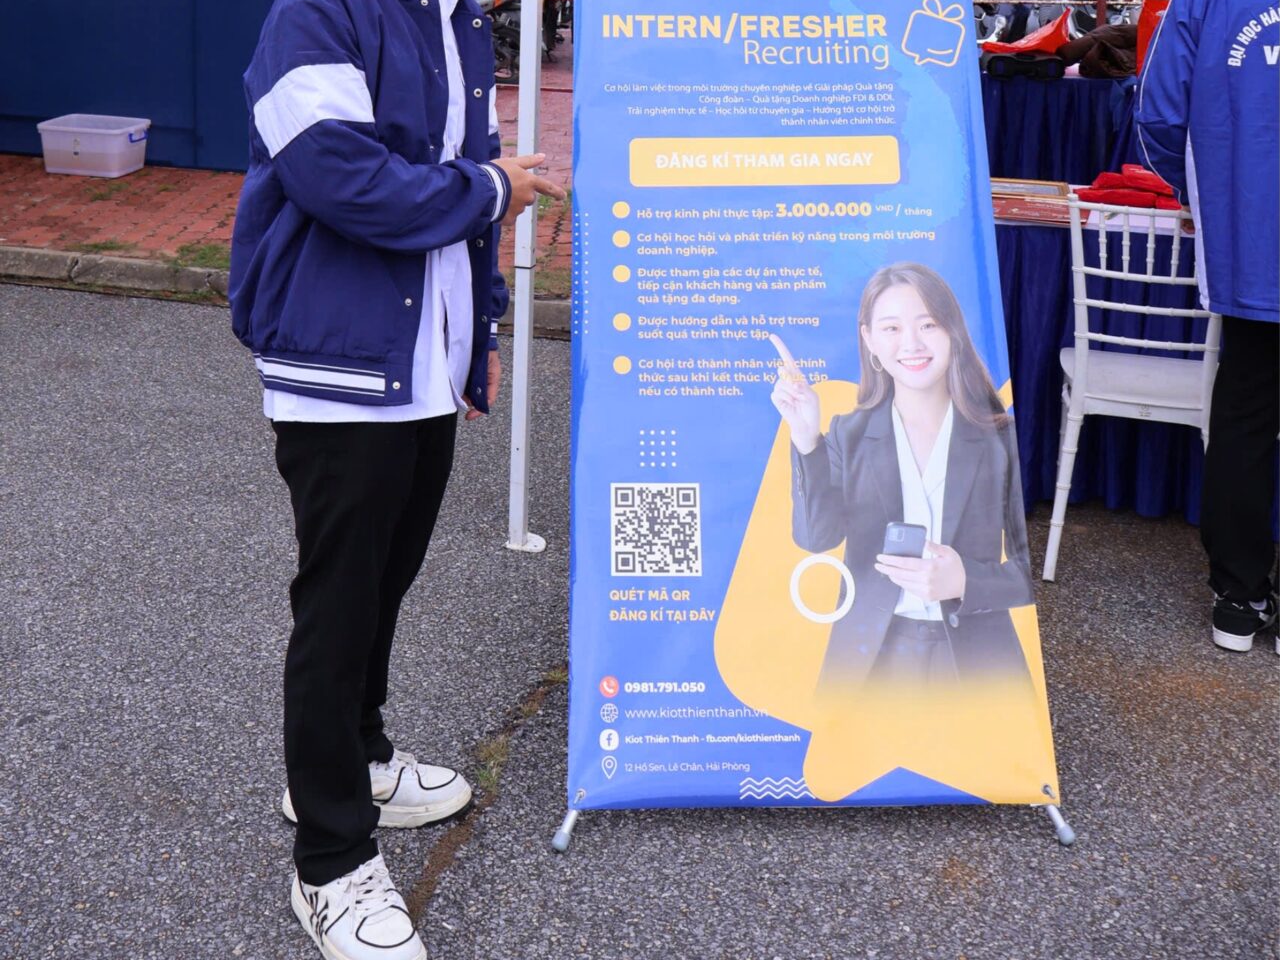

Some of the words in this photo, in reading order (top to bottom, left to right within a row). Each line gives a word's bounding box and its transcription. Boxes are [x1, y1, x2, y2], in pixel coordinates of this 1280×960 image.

[602, 13, 887, 44] INTERN/FRESHER
[1236, 19, 1262, 46] HỌC
[743, 40, 890, 70] Recruiting
[1227, 44, 1246, 67] ĐẠI
[655, 151, 708, 169] ĐĂNG
[734, 153, 785, 168] THAM
[789, 152, 820, 168] GIA
[825, 152, 874, 168] NGAY
[655, 209, 672, 221] trợ
[674, 208, 700, 218] kinh
[702, 208, 721, 220] phí
[723, 209, 749, 219] thực
[775, 202, 872, 218] 3.000.000
[904, 207, 933, 217] tháng
[654, 233, 672, 245] hội
[674, 233, 696, 245] học
[734, 232, 760, 243] phát
[839, 232, 870, 242] trong
[873, 231, 894, 240] môi
[897, 230, 936, 241] trường
[636, 246, 673, 256] doanh
[675, 246, 718, 257] nghiệp.
[637, 267, 667, 279] Được
[670, 268, 700, 277] tham
[702, 267, 720, 279] gia
[722, 267, 742, 277] các
[745, 267, 760, 278] dự
[763, 267, 777, 276] án
[779, 267, 805, 278] thực
[637, 280, 660, 291] tiếp
[662, 281, 683, 292] cận
[686, 280, 721, 290] khách
[723, 281, 752, 292] hàng
[755, 281, 768, 290] và
[637, 294, 659, 305] quà
[662, 294, 689, 305] tặng
[691, 294, 705, 303] đa
[638, 316, 668, 327] Được
[735, 316, 749, 325] và
[768, 316, 785, 327] trợ
[788, 316, 820, 326] trong
[638, 329, 663, 339] suốt
[721, 329, 748, 340] thực
[656, 359, 674, 371] hội
[697, 359, 731, 368] thành
[734, 359, 763, 368] nhân
[639, 372, 665, 382] thức
[668, 374, 688, 382] sau
[691, 372, 709, 382] khi
[712, 372, 731, 382] kết
[734, 372, 760, 382] thúc
[639, 386, 661, 396] nếu
[664, 386, 678, 396] có
[681, 386, 715, 395] thành
[609, 587, 645, 600] QUÉT
[648, 587, 668, 600] MÃ
[671, 590, 690, 600] QR
[609, 607, 647, 621] ĐĂNG
[650, 607, 663, 621] KÍ
[666, 610, 686, 624] TẠI
[689, 607, 715, 621] ĐÂY
[624, 682, 705, 693] 0981.791.050
[625, 706, 768, 718] www.kiotthienthanh.vn
[625, 734, 643, 744] Kiot
[645, 734, 669, 744] Thiên
[672, 734, 699, 744] Thanh
[722, 761, 750, 773] Phòng
